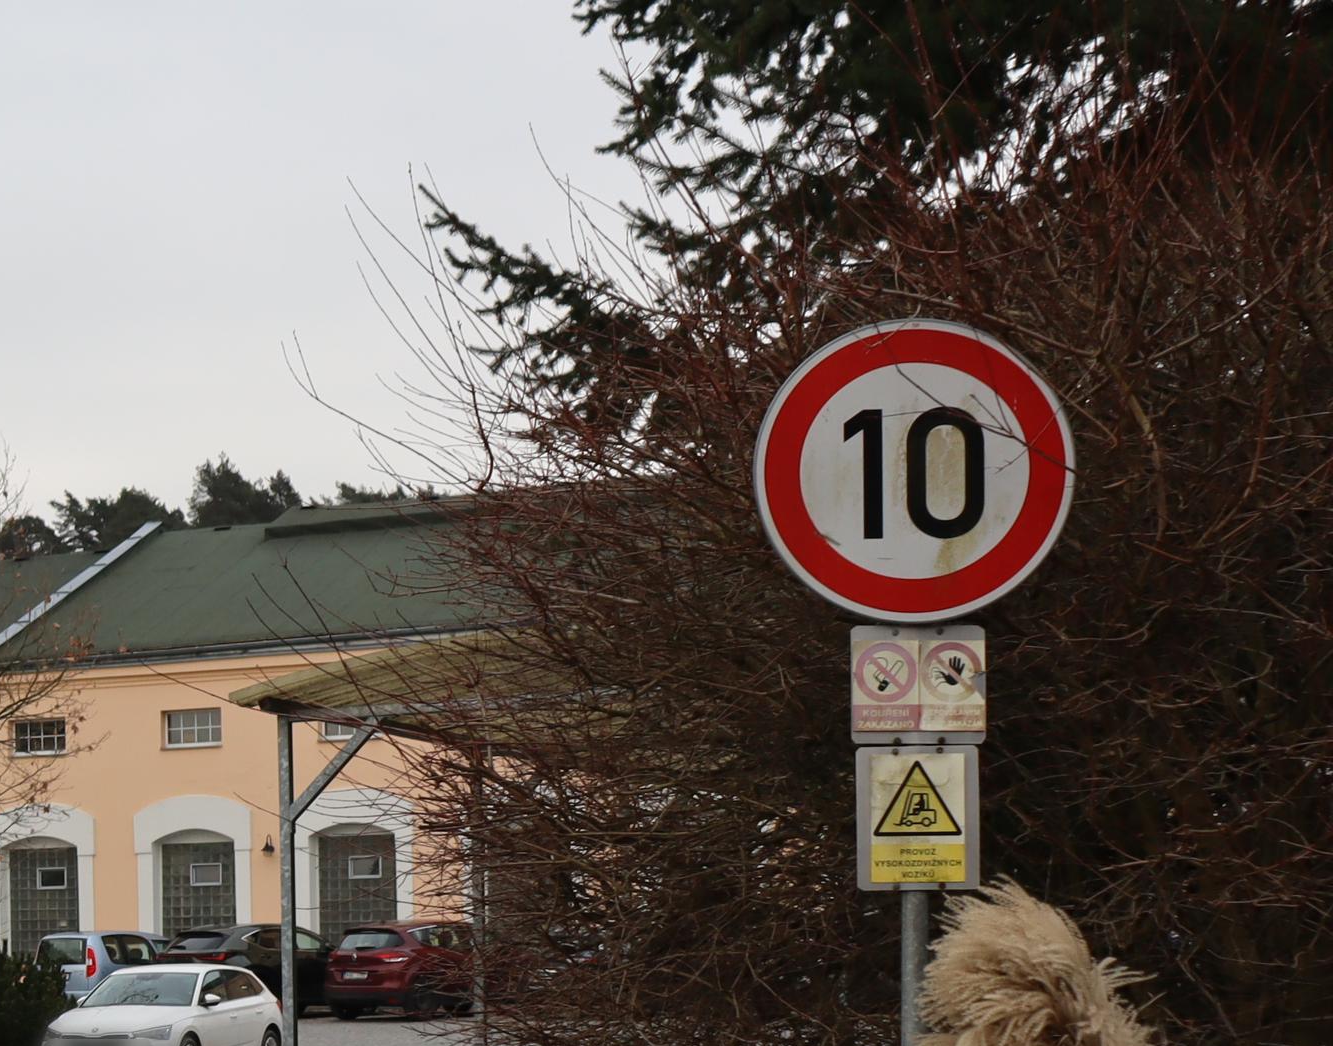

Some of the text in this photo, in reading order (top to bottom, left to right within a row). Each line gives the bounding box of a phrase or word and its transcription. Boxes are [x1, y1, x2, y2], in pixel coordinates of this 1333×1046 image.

[844, 407, 985, 539] 10
[899, 848, 937, 856] PROVOZ
[874, 858, 962, 867] VYSOKOZDVIŽNÝCH
